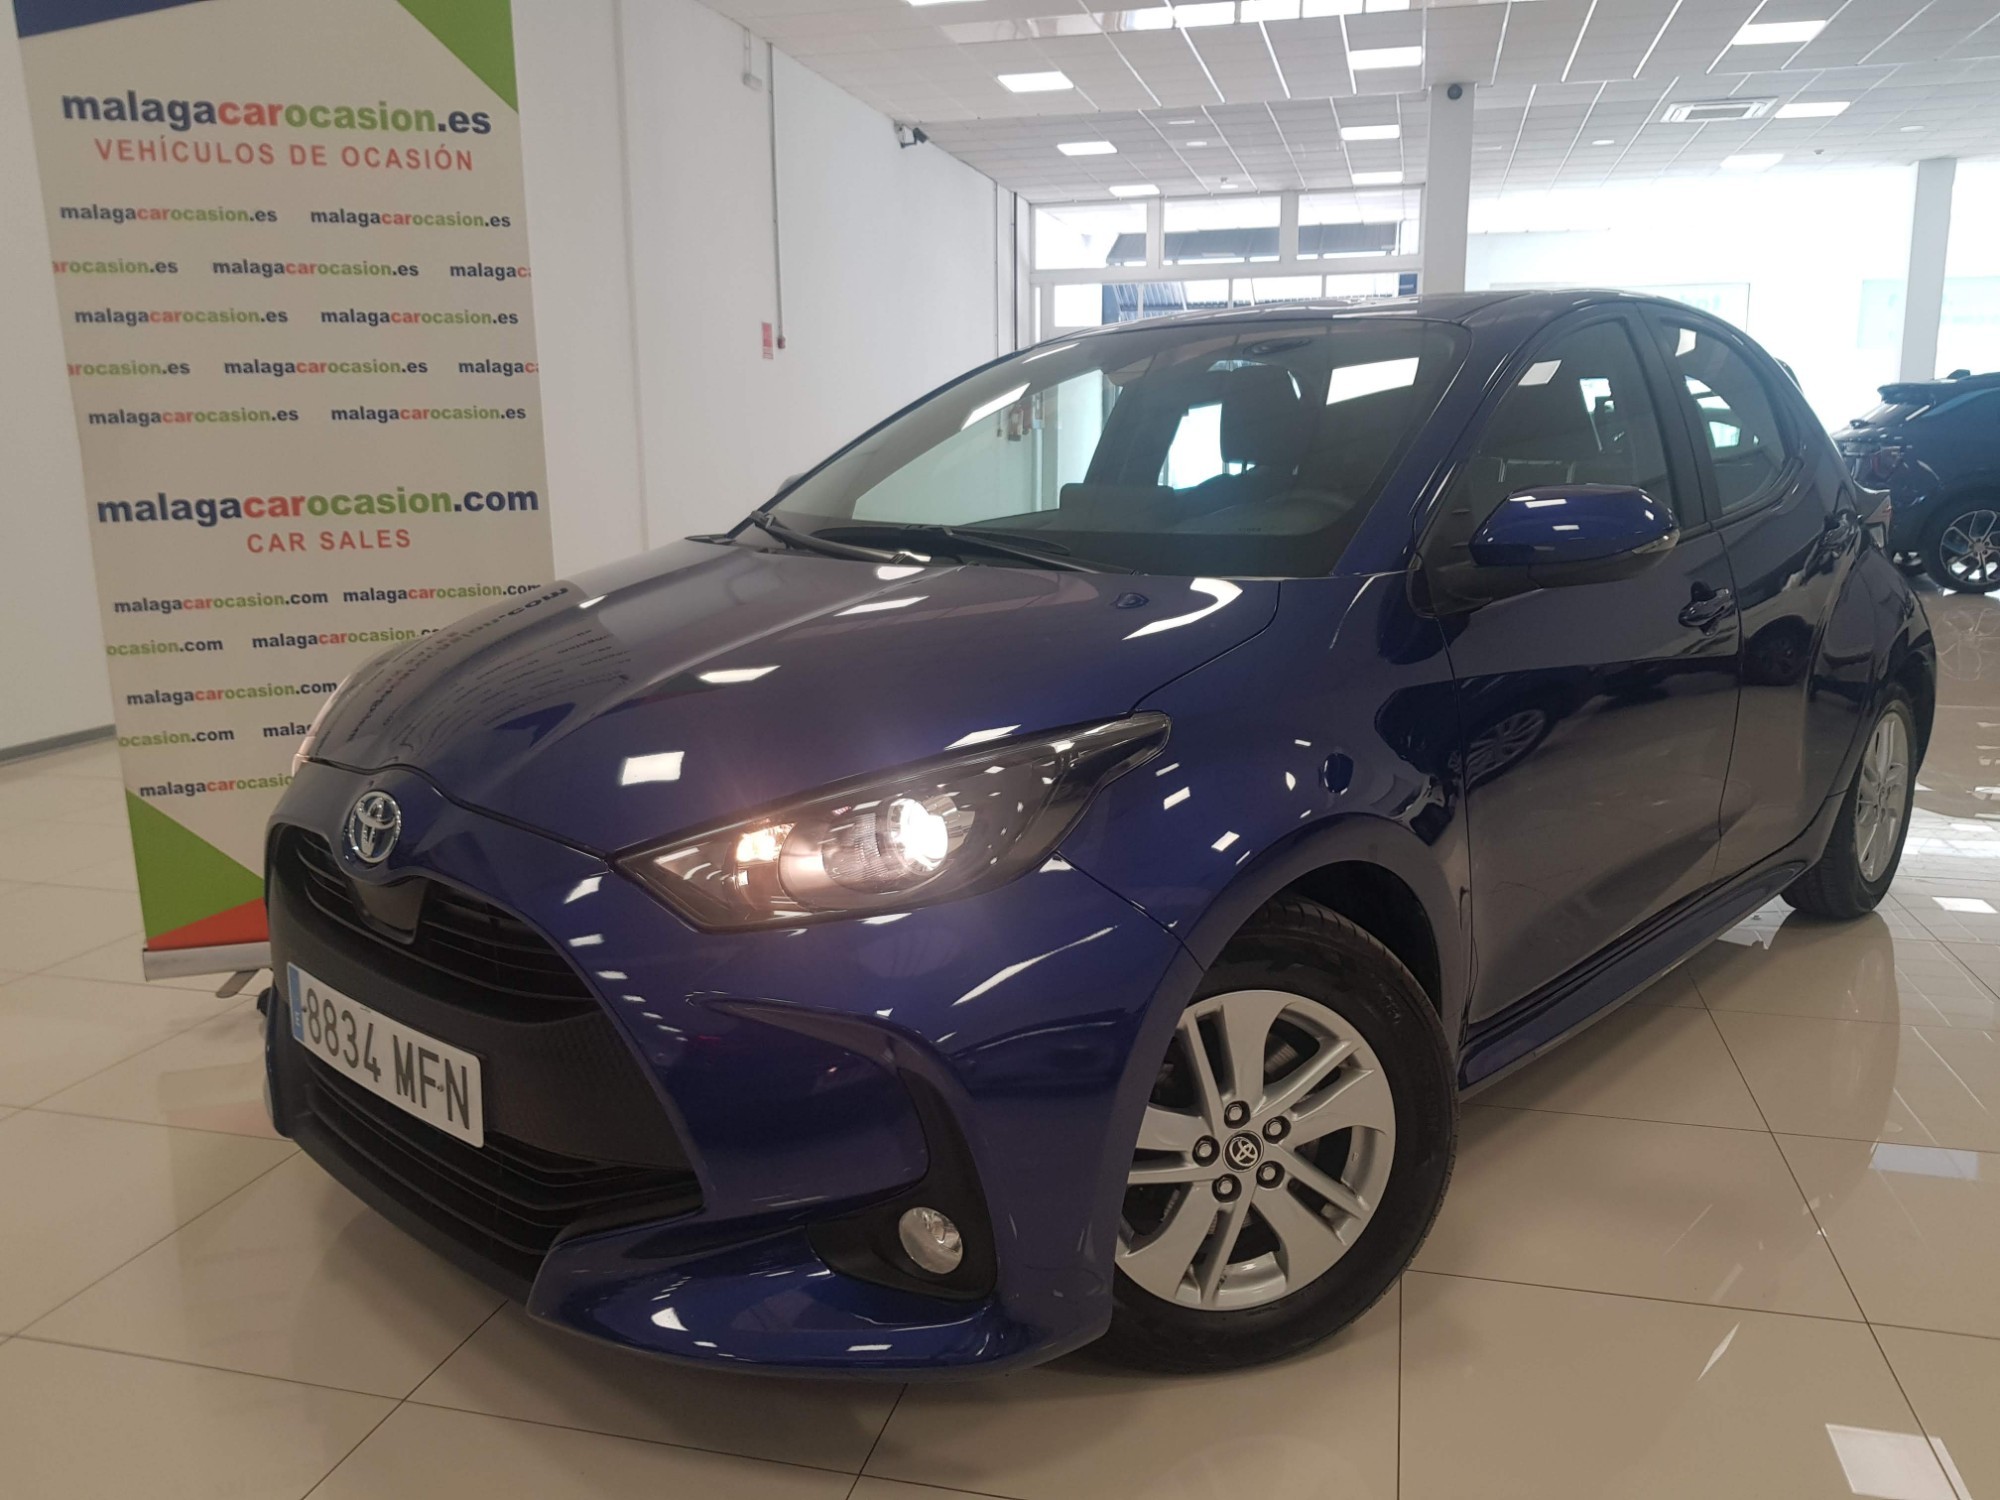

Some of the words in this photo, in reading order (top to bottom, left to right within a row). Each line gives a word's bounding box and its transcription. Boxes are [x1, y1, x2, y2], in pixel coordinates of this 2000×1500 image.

[61, 90, 492, 134] malagacarocasion.es
[94, 135, 275, 165] VEHÍCULOS
[289, 144, 327, 166] DE
[341, 144, 473, 170] OCASIÓN
[60, 204, 278, 224] malagacarocasion.es
[310, 208, 511, 228] malagacarocasion.es
[212, 259, 419, 278] malagacarocasion.es
[450, 263, 531, 281] malagac
[75, 308, 288, 327] malagacarocasion.es
[320, 309, 519, 327] malagacarocasion.es
[224, 359, 428, 377] malagacarocasion.es
[458, 359, 539, 377] malagac
[88, 408, 299, 425] malagacarocasion.es
[331, 405, 527, 424] malagacarocasion.es
[97, 487, 539, 527] malagacarocasion.com
[246, 532, 306, 554] CAR
[319, 528, 411, 551] SALES
[114, 592, 329, 614] malagacarocasion.com
[106, 637, 224, 656] ocasion.com
[127, 682, 337, 705] malagacarocasion.com
[118, 729, 235, 748] ocasion.com
[307, 988, 381, 1083] 8834
[393, 1034, 470, 1130] MFN
